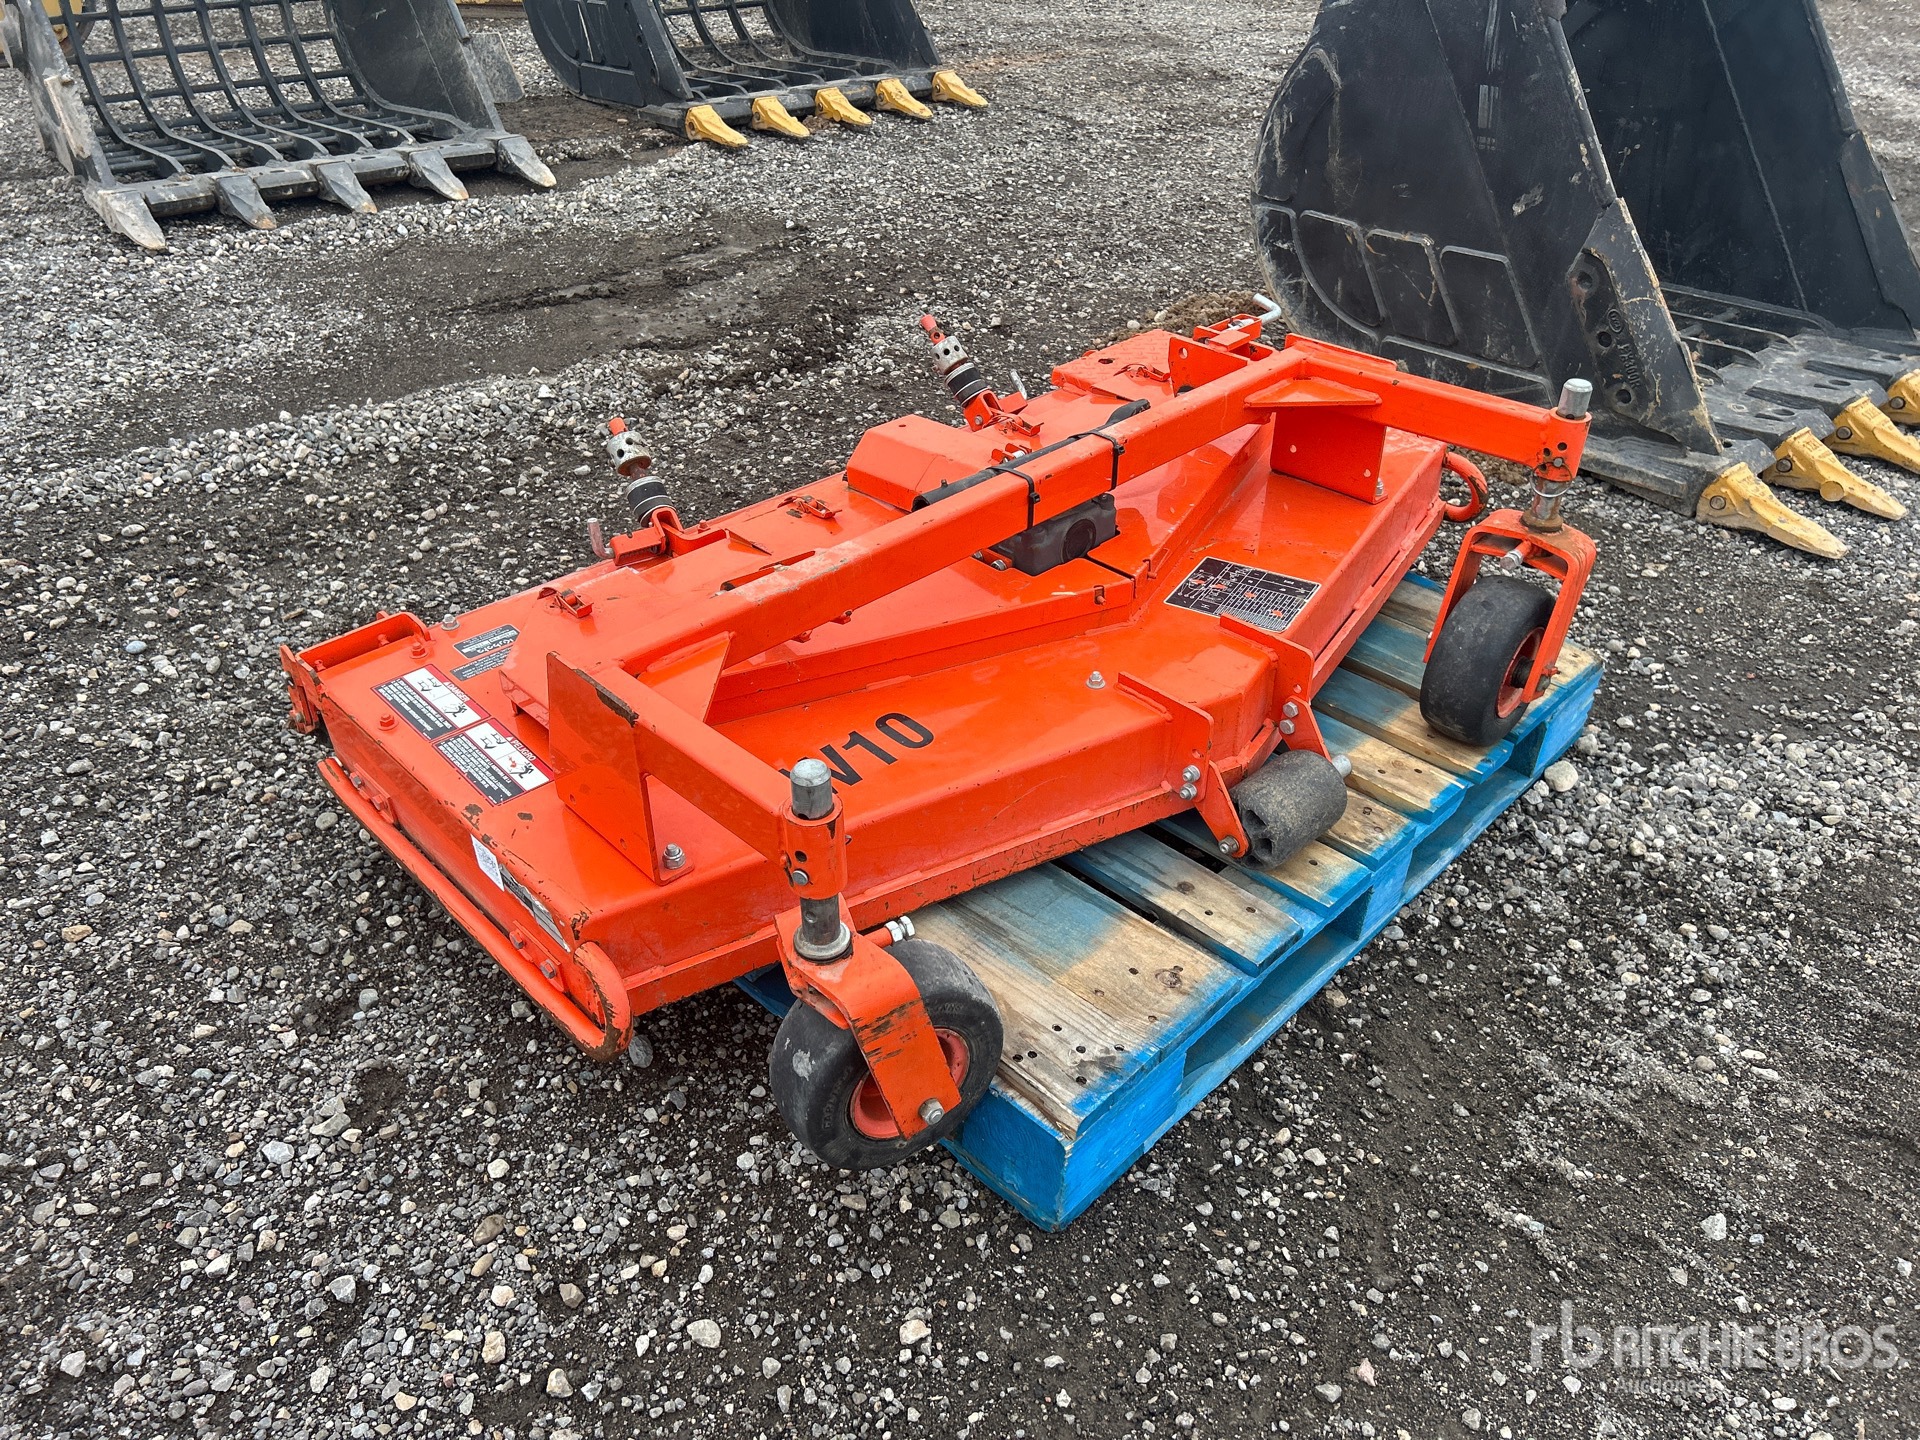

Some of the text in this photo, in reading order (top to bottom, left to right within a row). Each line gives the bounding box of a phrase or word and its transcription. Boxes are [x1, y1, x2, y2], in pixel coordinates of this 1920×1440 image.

[477, 639, 514, 653] Kubota
[447, 683, 470, 702] DANGER
[513, 740, 537, 761] PELIGRO
